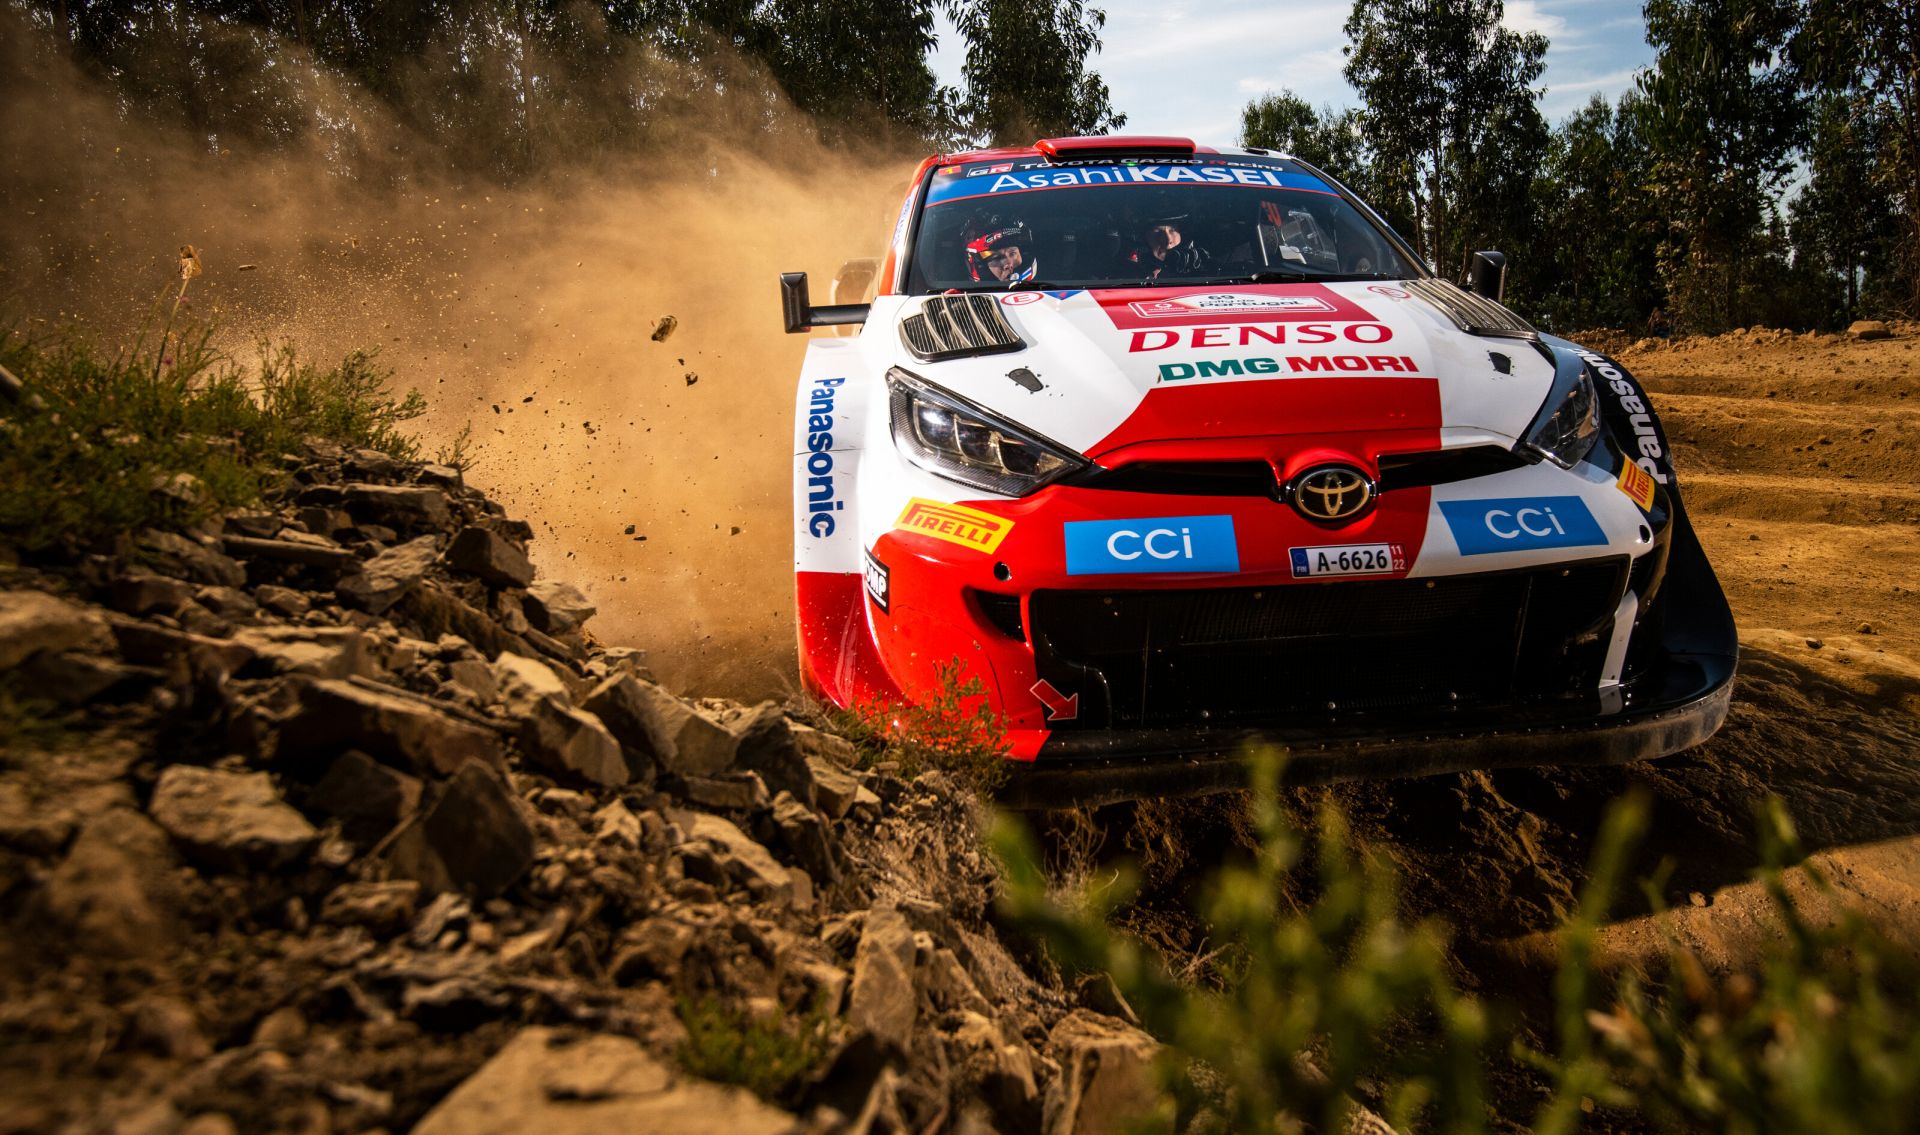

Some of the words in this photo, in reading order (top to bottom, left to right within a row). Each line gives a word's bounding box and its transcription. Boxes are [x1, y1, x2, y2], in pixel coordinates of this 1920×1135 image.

[969, 165, 1011, 177] GR
[1020, 159, 1114, 170] TOYOTA
[1209, 159, 1284, 172] Racing
[1128, 323, 1394, 353] DENSO
[1158, 357, 1280, 382] DMG
[1285, 355, 1420, 373] MORI
[807, 377, 846, 539] Panasonic
[902, 503, 1001, 546] PIRELLI
[1317, 549, 1388, 572] A-6626
[1391, 545, 1402, 555] 11
[1393, 559, 1405, 570] 22
[865, 559, 887, 598] OMP
